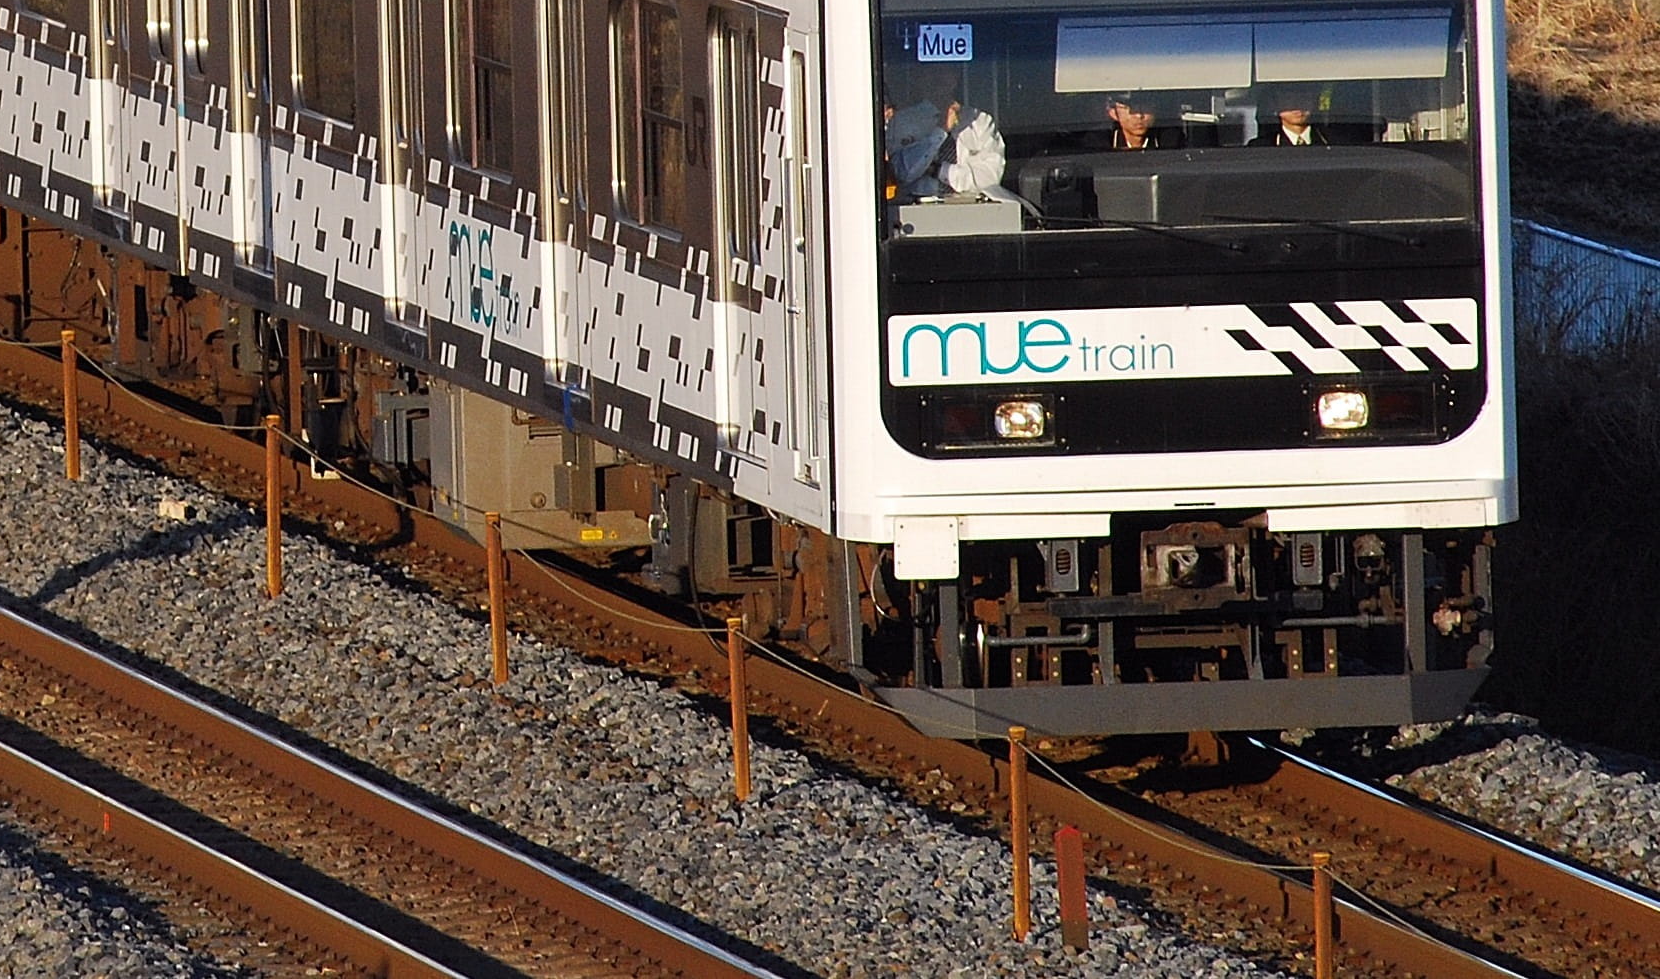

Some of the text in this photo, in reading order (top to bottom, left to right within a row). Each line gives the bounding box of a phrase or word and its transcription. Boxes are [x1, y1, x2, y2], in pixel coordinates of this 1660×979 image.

[922, 32, 968, 56] Mue
[902, 318, 1174, 377] mue train
